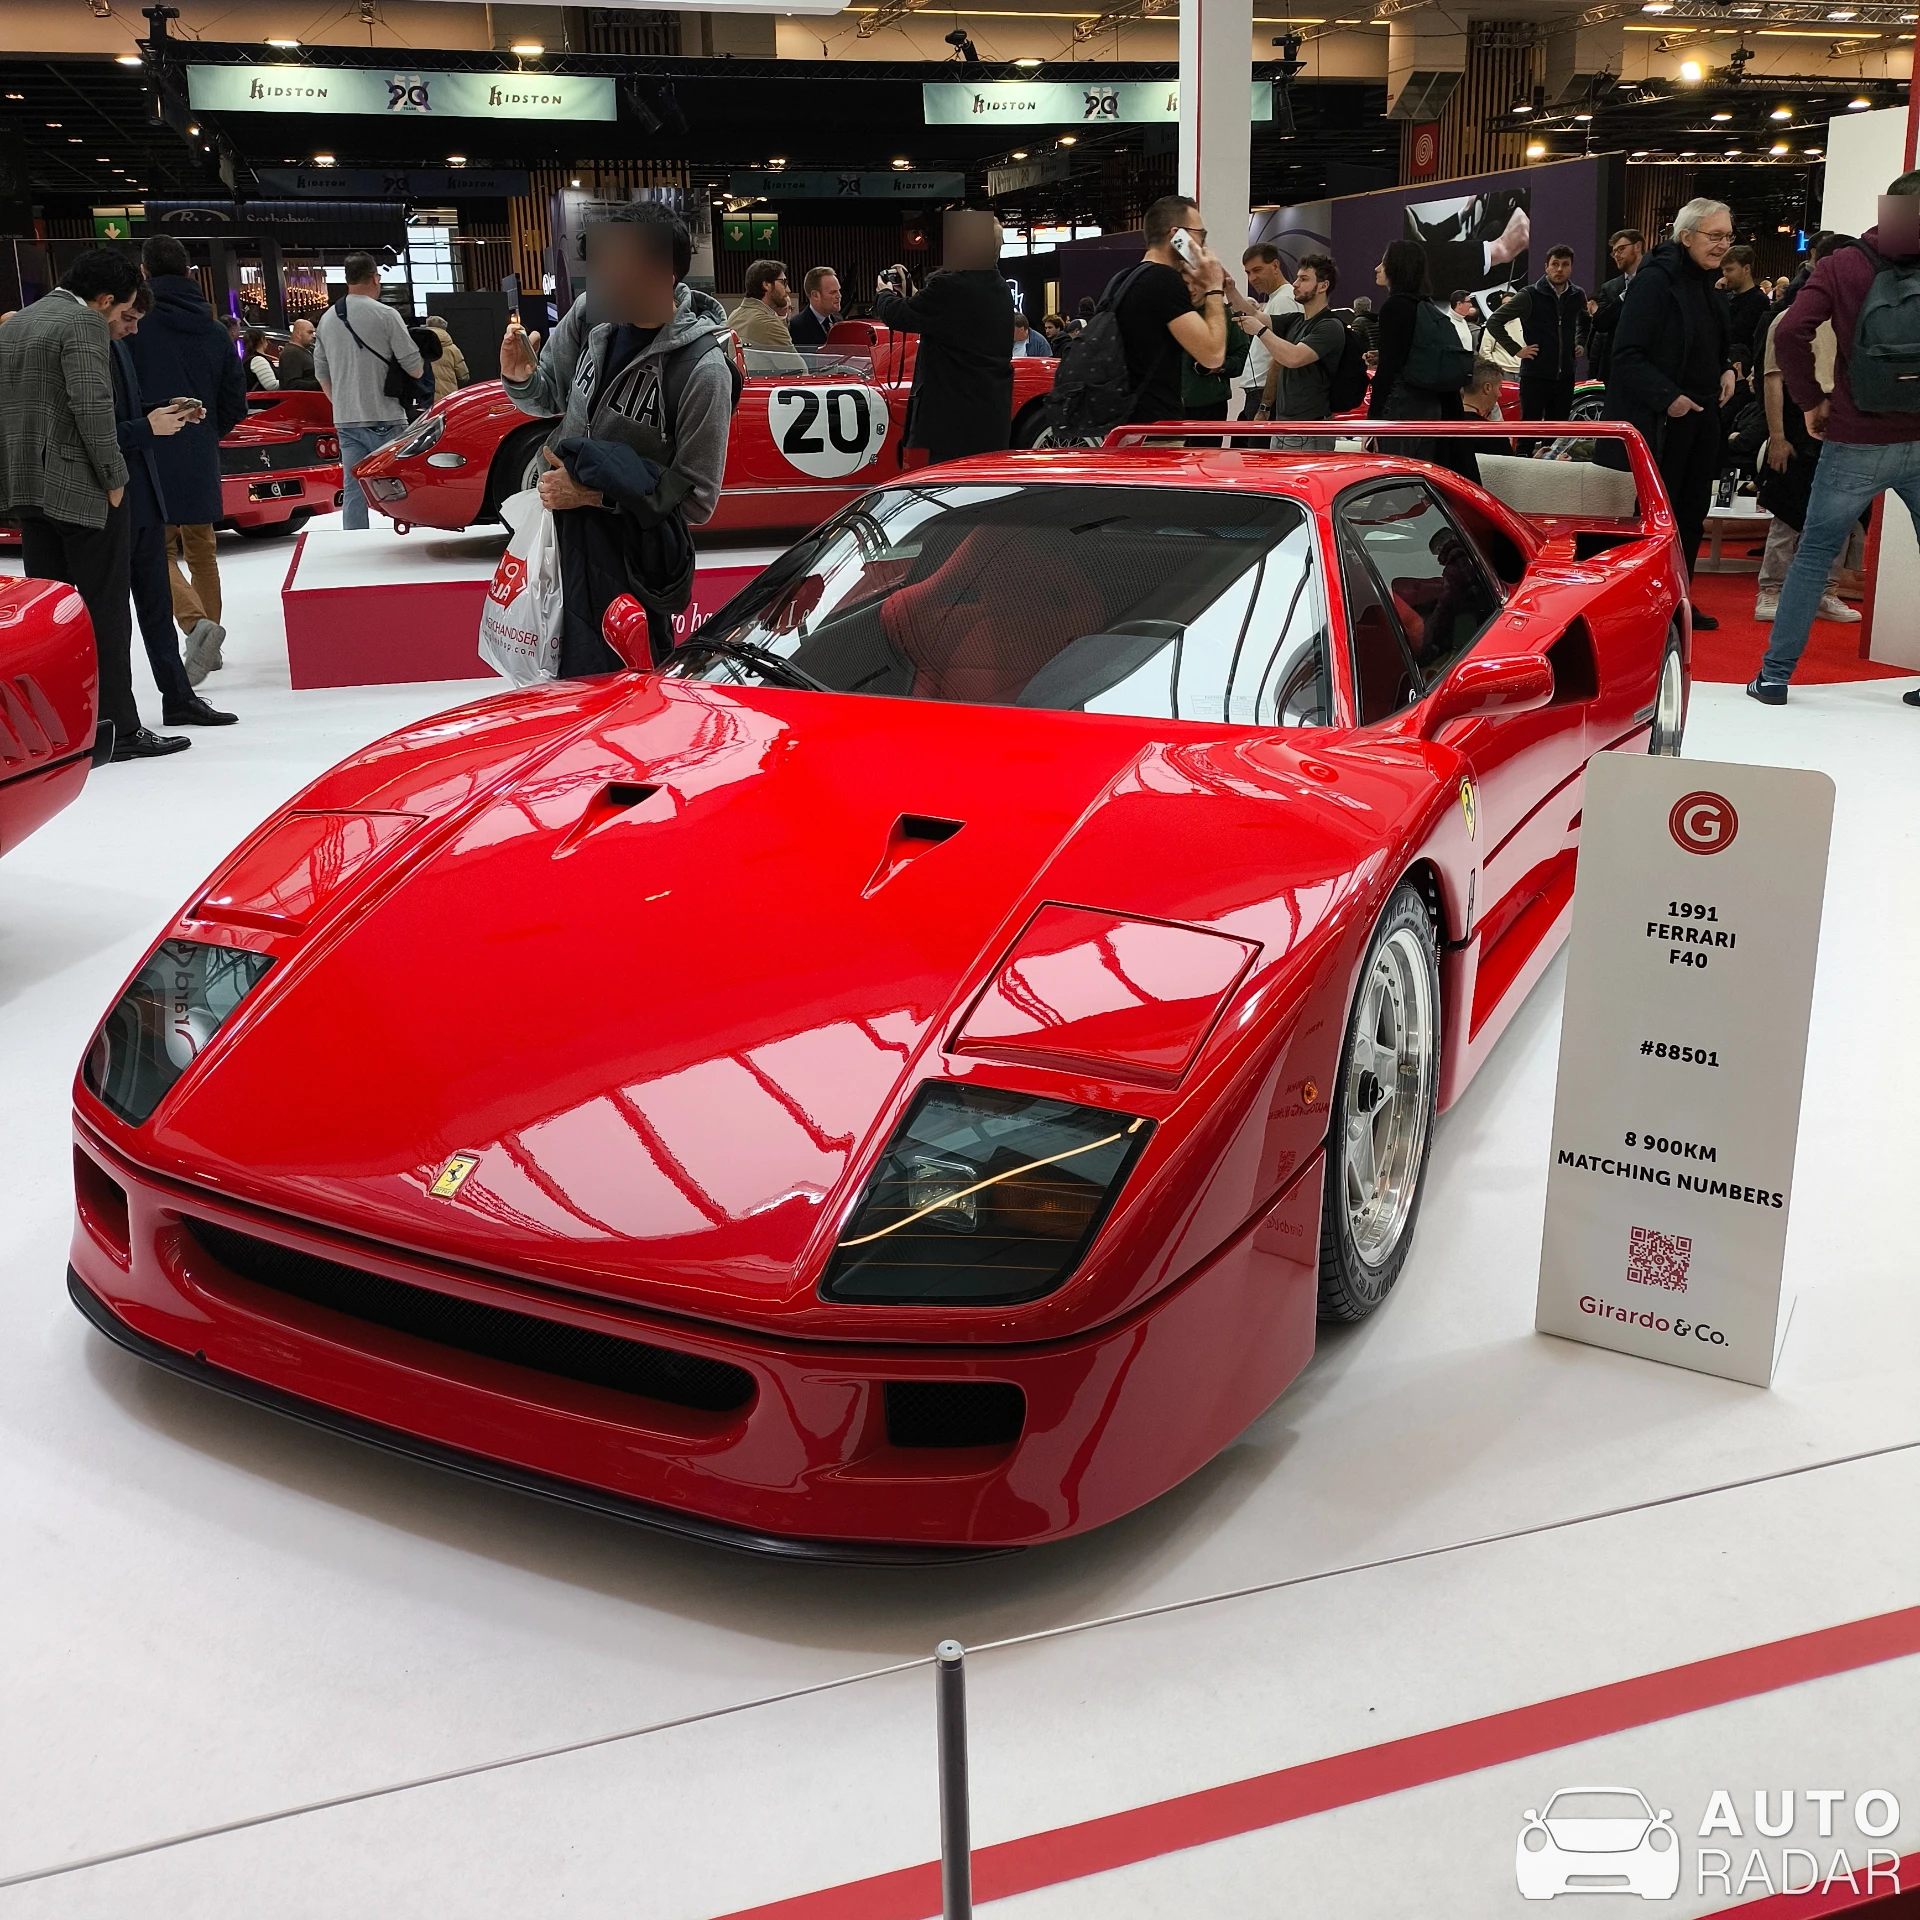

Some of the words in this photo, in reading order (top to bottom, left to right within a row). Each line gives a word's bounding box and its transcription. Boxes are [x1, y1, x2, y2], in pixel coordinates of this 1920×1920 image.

[249, 77, 329, 100] KIDSTON
[488, 85, 563, 107] KIDSTON
[972, 93, 1036, 114] KIDSTON
[778, 389, 870, 454] 20
[1668, 901, 1719, 922] 1991
[1647, 922, 1737, 949] FERRARI
[1669, 949, 1708, 969] F40
[1640, 1040, 1720, 1068] #88501
[1624, 1131, 1637, 1147] 8
[1643, 1134, 1717, 1163] 900KM
[1557, 1150, 1671, 1187] MATCHING
[1676, 1173, 1785, 1209] NUMBERS
